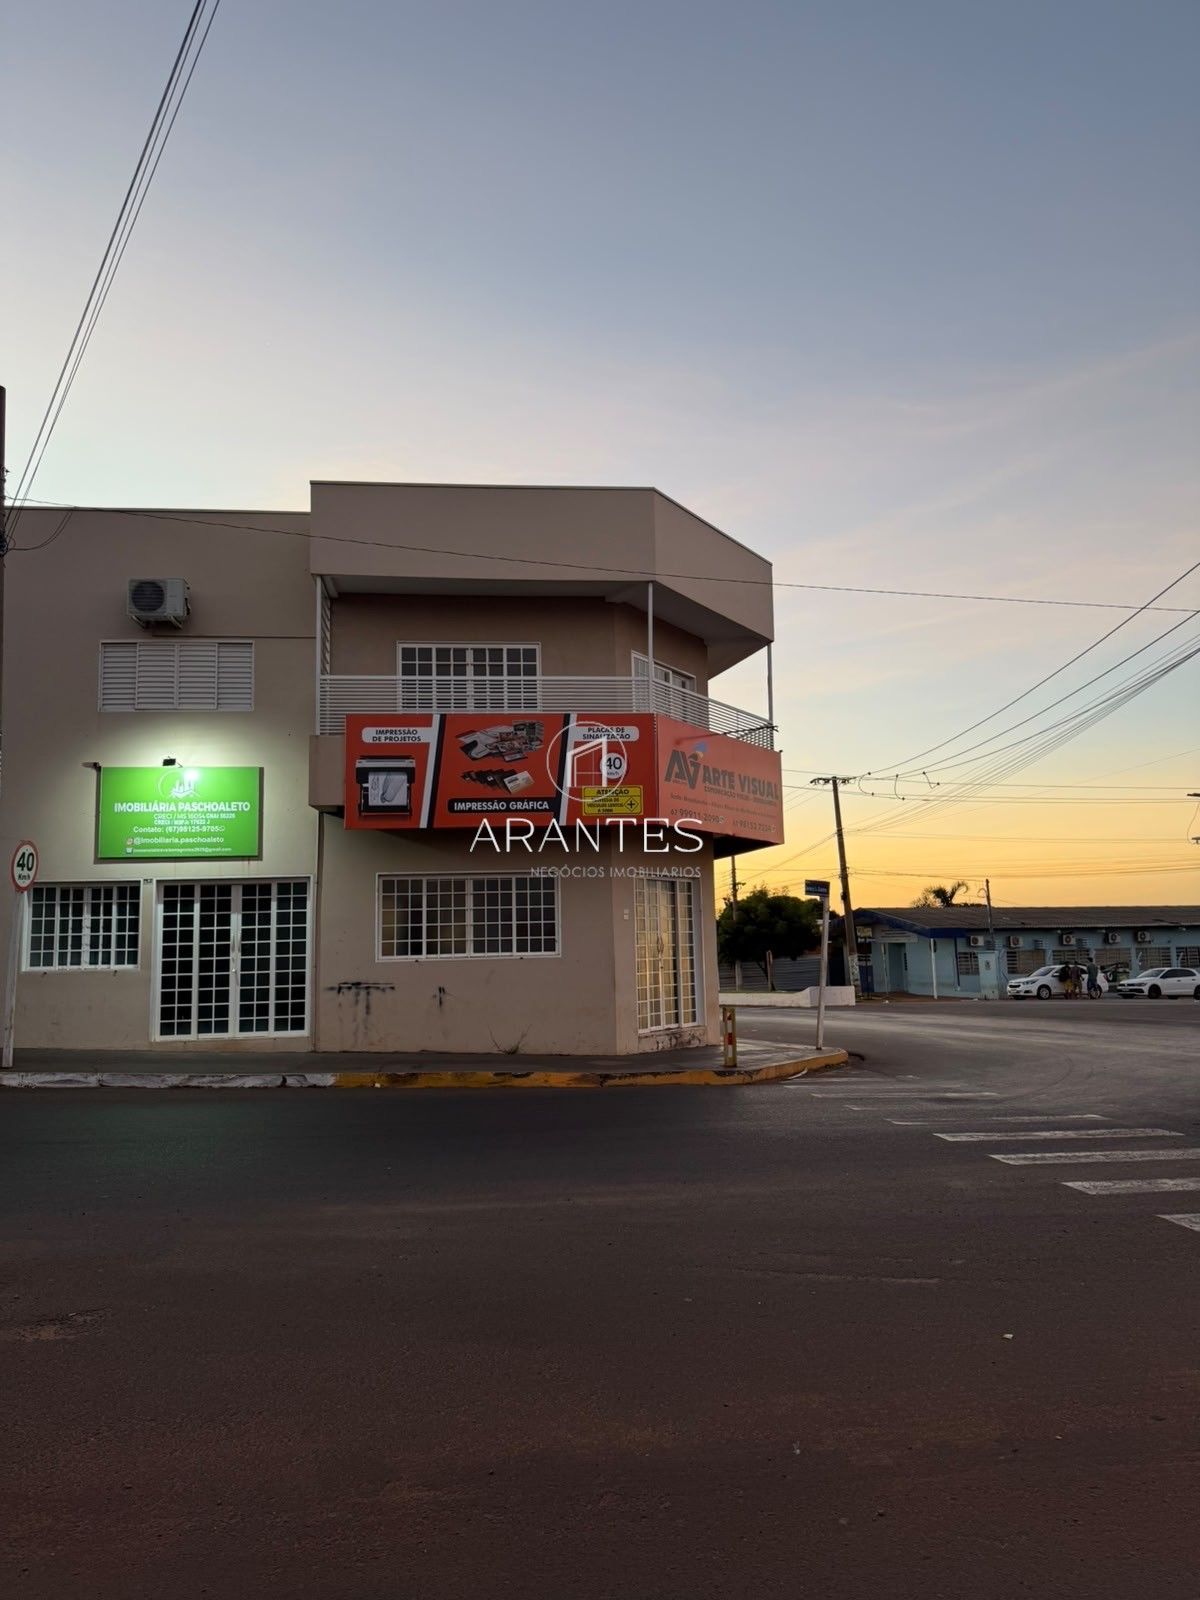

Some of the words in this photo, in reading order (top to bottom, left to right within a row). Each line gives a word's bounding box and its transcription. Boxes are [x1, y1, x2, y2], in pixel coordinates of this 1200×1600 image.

[606, 757, 622, 770] 40
[702, 765, 736, 790] ARTE
[738, 773, 780, 801] VISUAL
[114, 800, 176, 812] IMOBILIÁRIA
[180, 801, 251, 812] PASCHOALETO
[453, 800, 507, 811] IMPRESSÃO
[509, 799, 550, 810] GRÁFICA
[16, 852, 35, 872] 40
